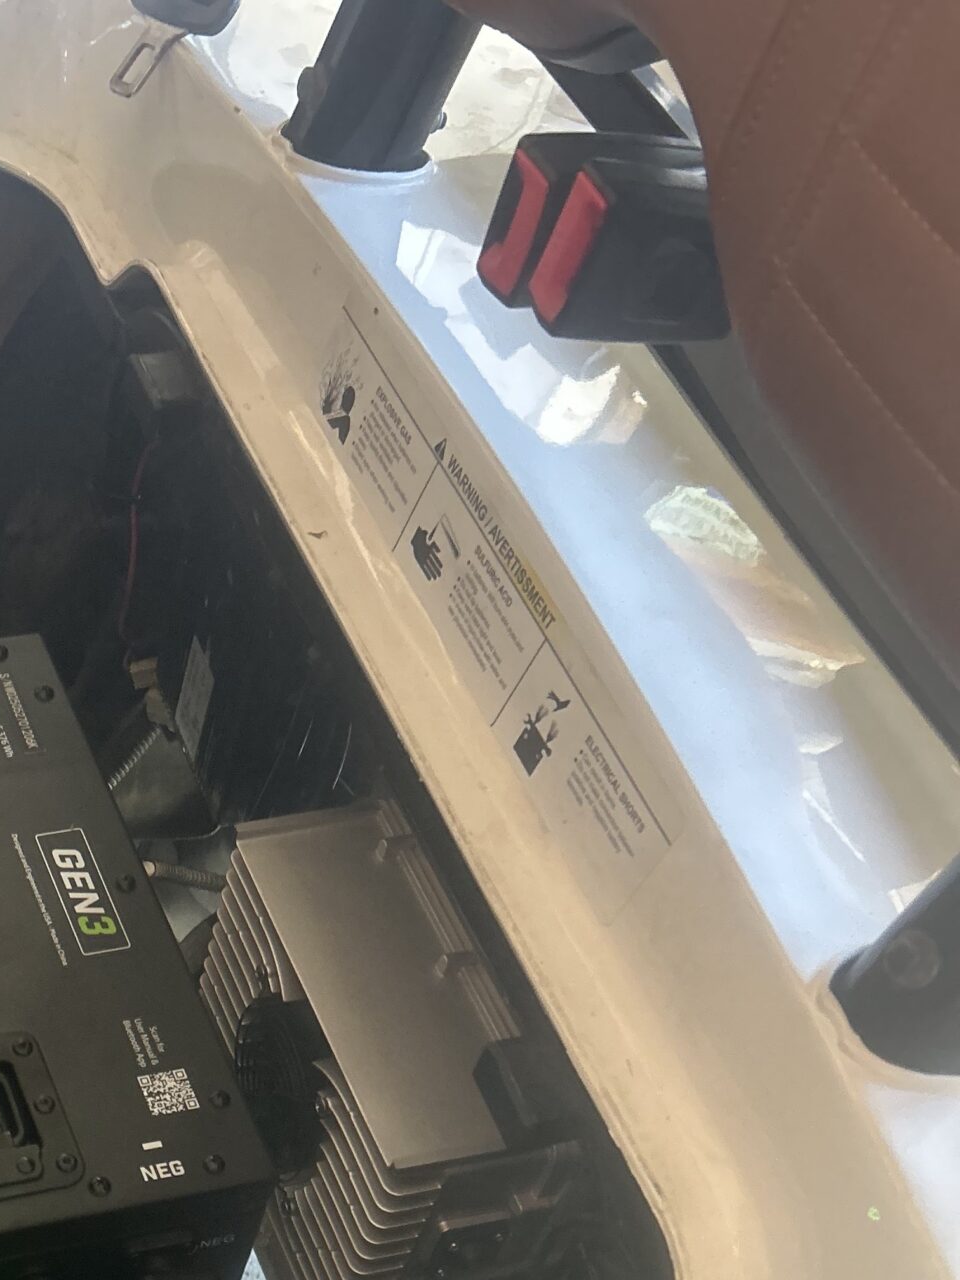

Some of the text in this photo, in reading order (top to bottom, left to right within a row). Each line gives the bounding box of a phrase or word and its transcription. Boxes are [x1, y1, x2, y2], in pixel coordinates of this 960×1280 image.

[448, 454, 488, 521] WARNING
[488, 524, 556, 629] AVERTISSMENT
[474, 545, 500, 588] SULFURIC
[498, 585, 512, 607] ACID
[585, 735, 620, 795] ELECTRICAL
[619, 792, 645, 833] SHORTS
[52, 849, 116, 934] GEN3
[123, 1020, 146, 1067] Bluetooth App
[134, 1018, 144, 1033] User
[140, 1034, 157, 1059] Manual
[149, 1026, 164, 1052] Scan for
[140, 1160, 185, 1182] NEG
